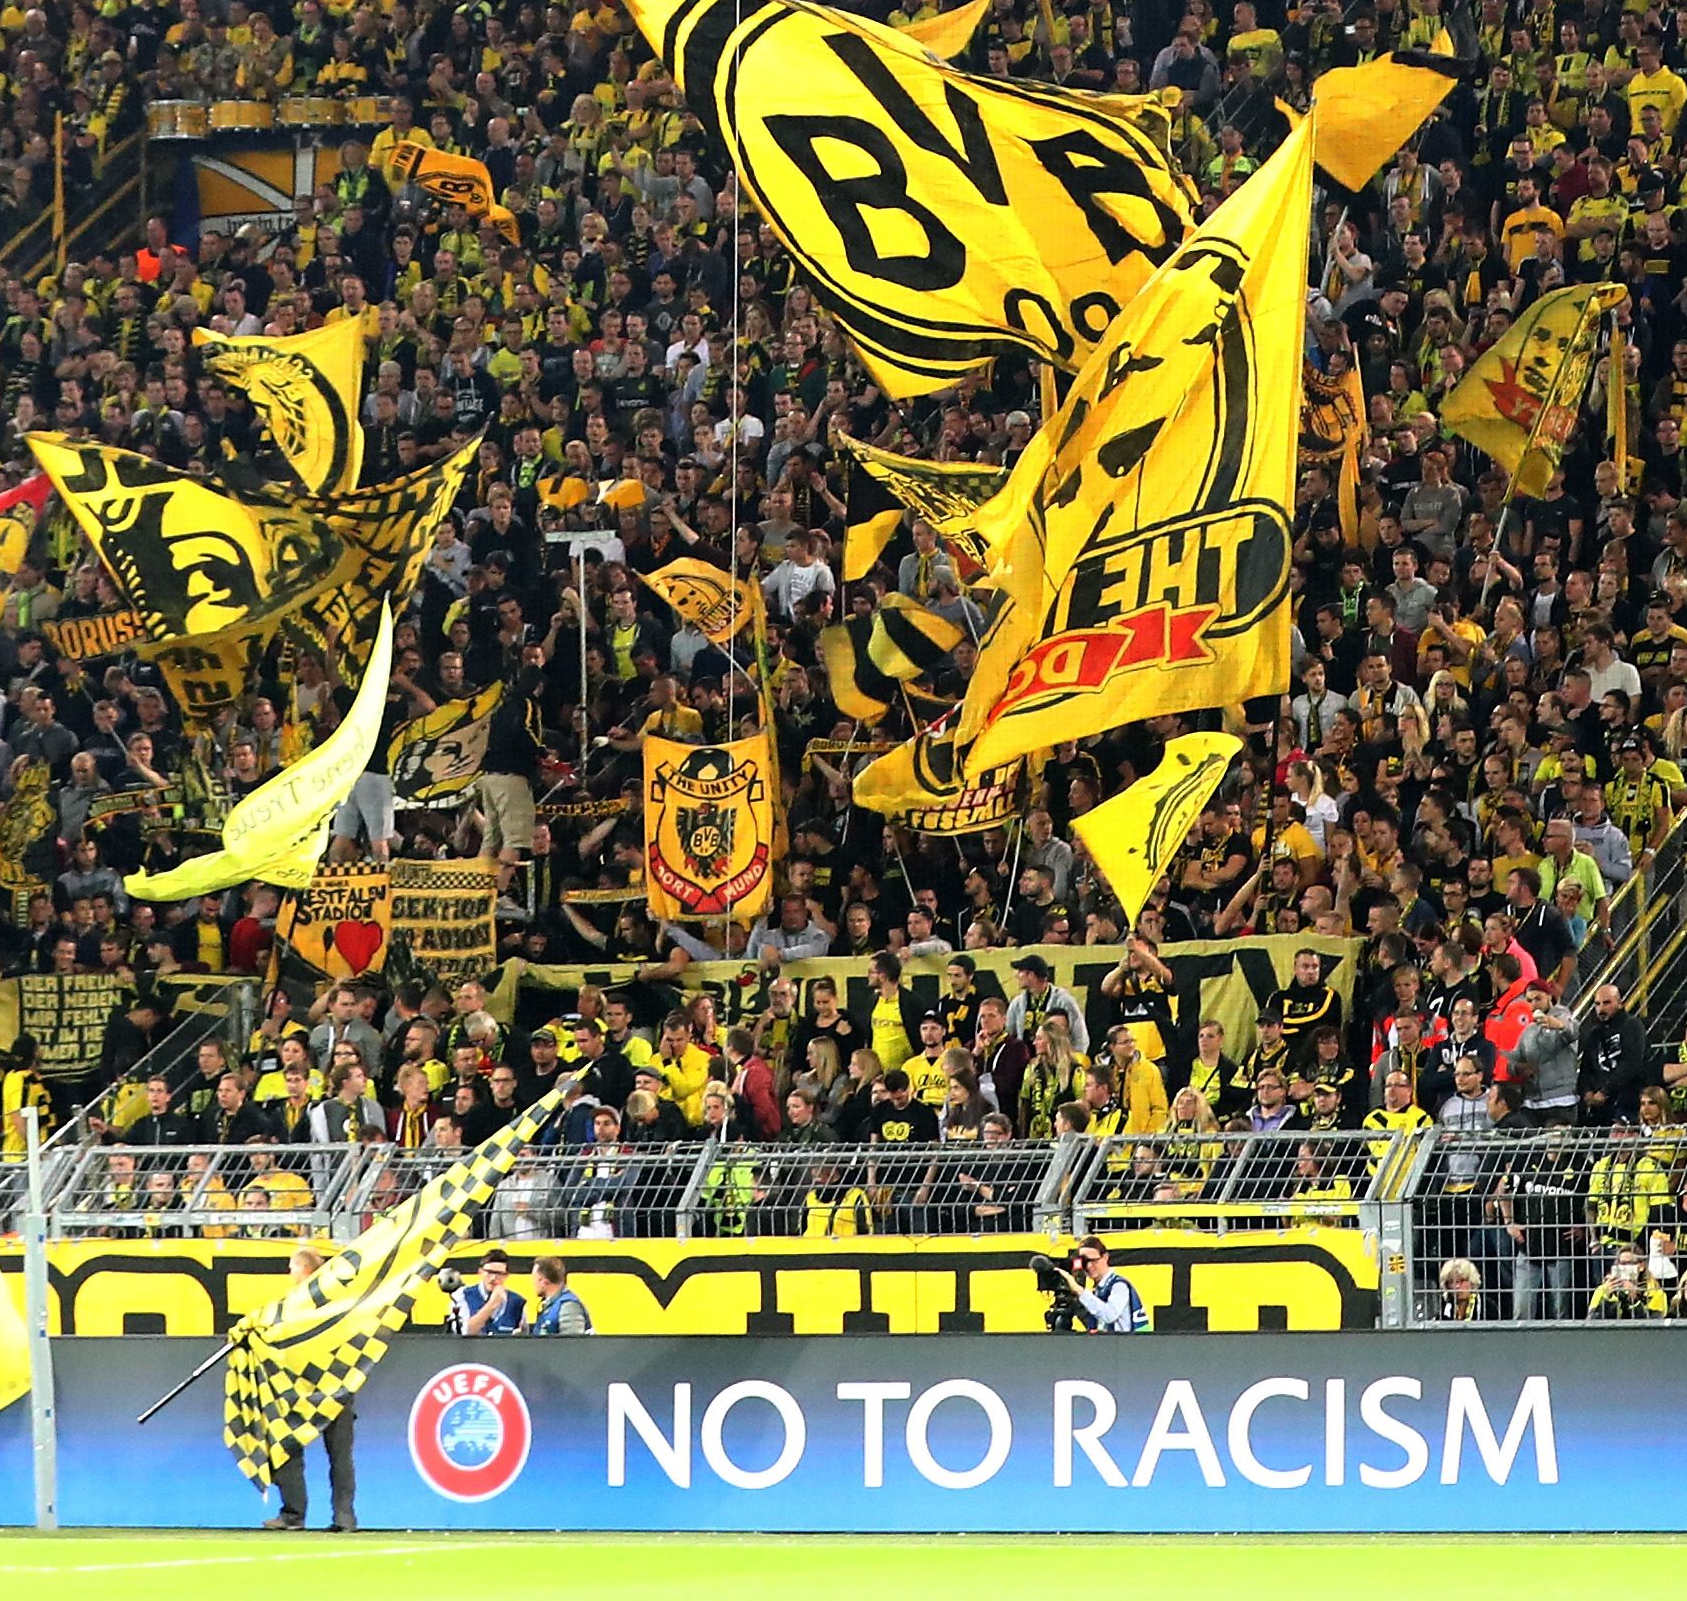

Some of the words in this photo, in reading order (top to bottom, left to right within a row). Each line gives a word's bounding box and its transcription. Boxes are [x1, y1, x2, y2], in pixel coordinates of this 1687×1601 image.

[762, 30, 1186, 292] BVB
[668, 769, 695, 793] THE
[699, 769, 750, 796] UNITY
[692, 828, 719, 849] BVB
[723, 863, 762, 901] MUND
[23, 974, 59, 992] DER
[23, 990, 59, 1009] DER
[23, 1009, 59, 1027] MIR
[62, 1007, 112, 1028] FEHLT
[431, 1372, 504, 1406] UEFA
[607, 1380, 806, 1489] NO
[837, 1379, 1012, 1489] TO
[1053, 1376, 1559, 1489] RACISM
